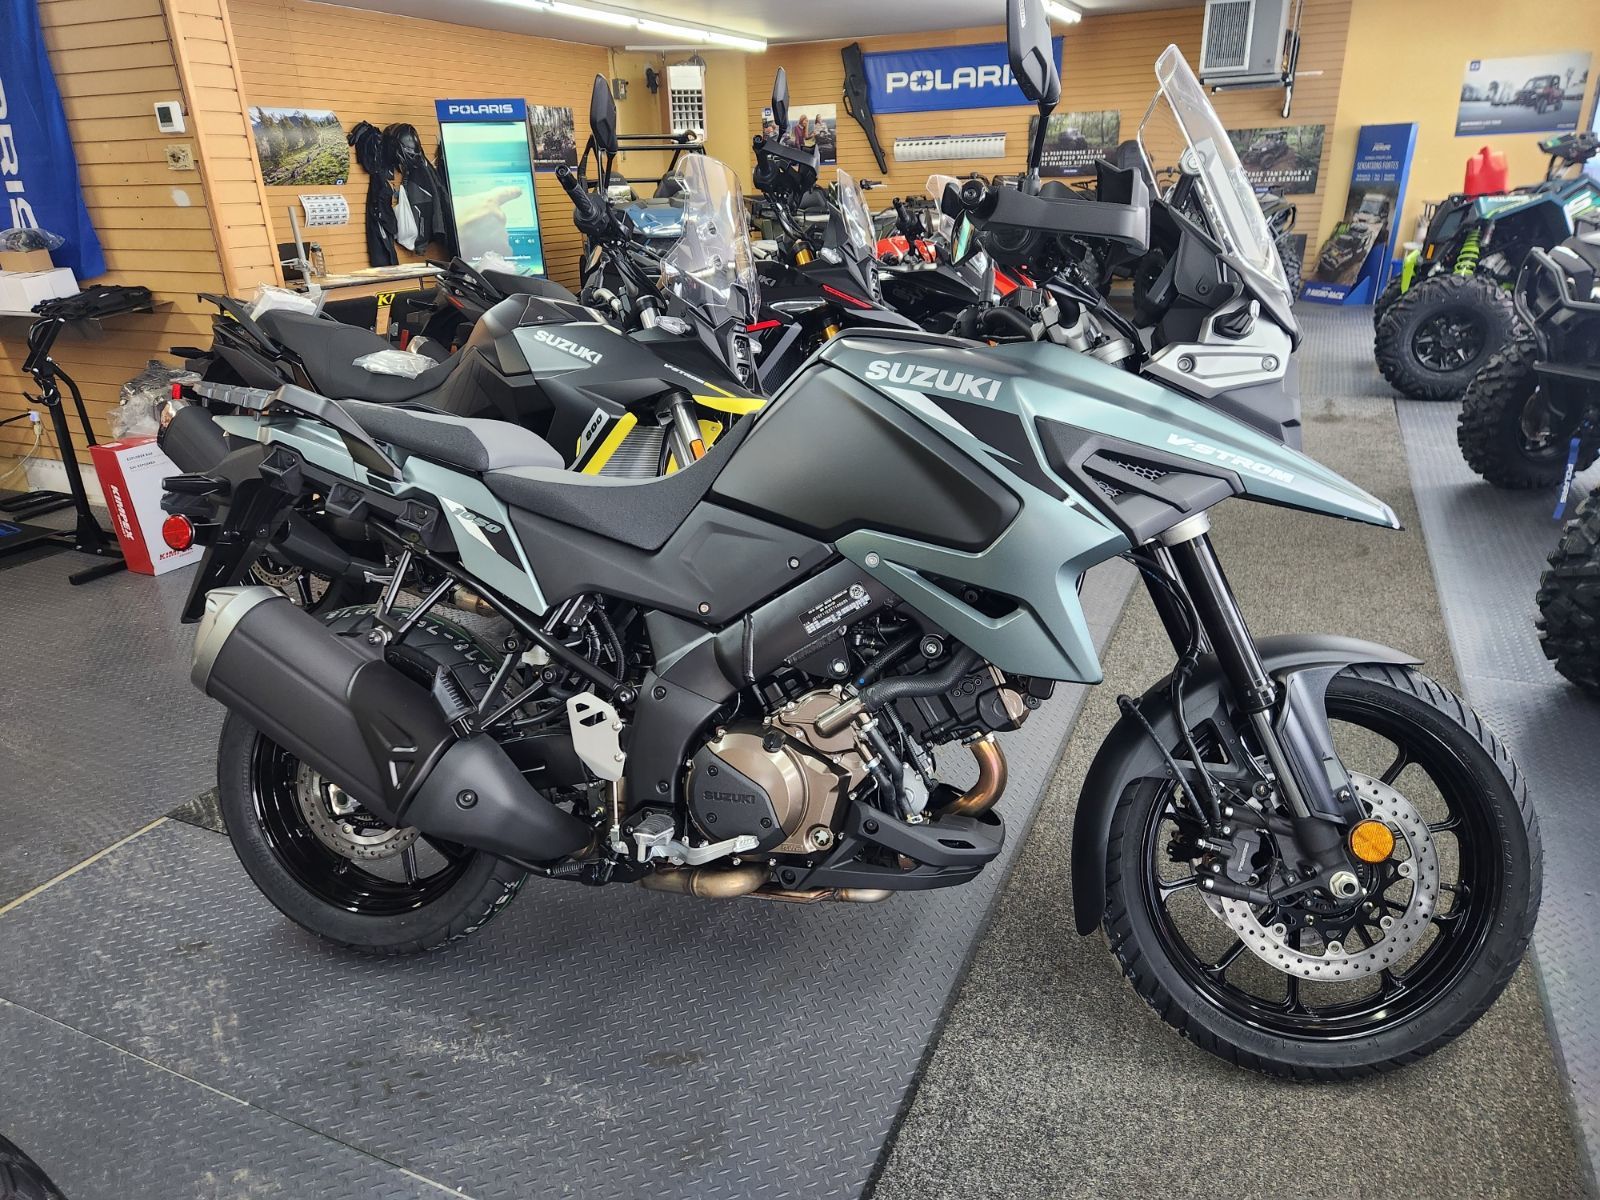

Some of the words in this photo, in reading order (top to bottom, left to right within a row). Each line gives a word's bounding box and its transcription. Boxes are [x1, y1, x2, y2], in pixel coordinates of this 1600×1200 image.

[886, 64, 1018, 94] POLARI
[449, 103, 514, 115] POLARIS
[534, 329, 603, 365] SUZUKI
[865, 360, 1002, 402] SUZUKI
[586, 414, 603, 442] 800
[1166, 433, 1295, 483] V-STROM
[110, 484, 135, 540] KIMPEX
[451, 508, 502, 534] 1050
[702, 790, 756, 805] SUZUKI
